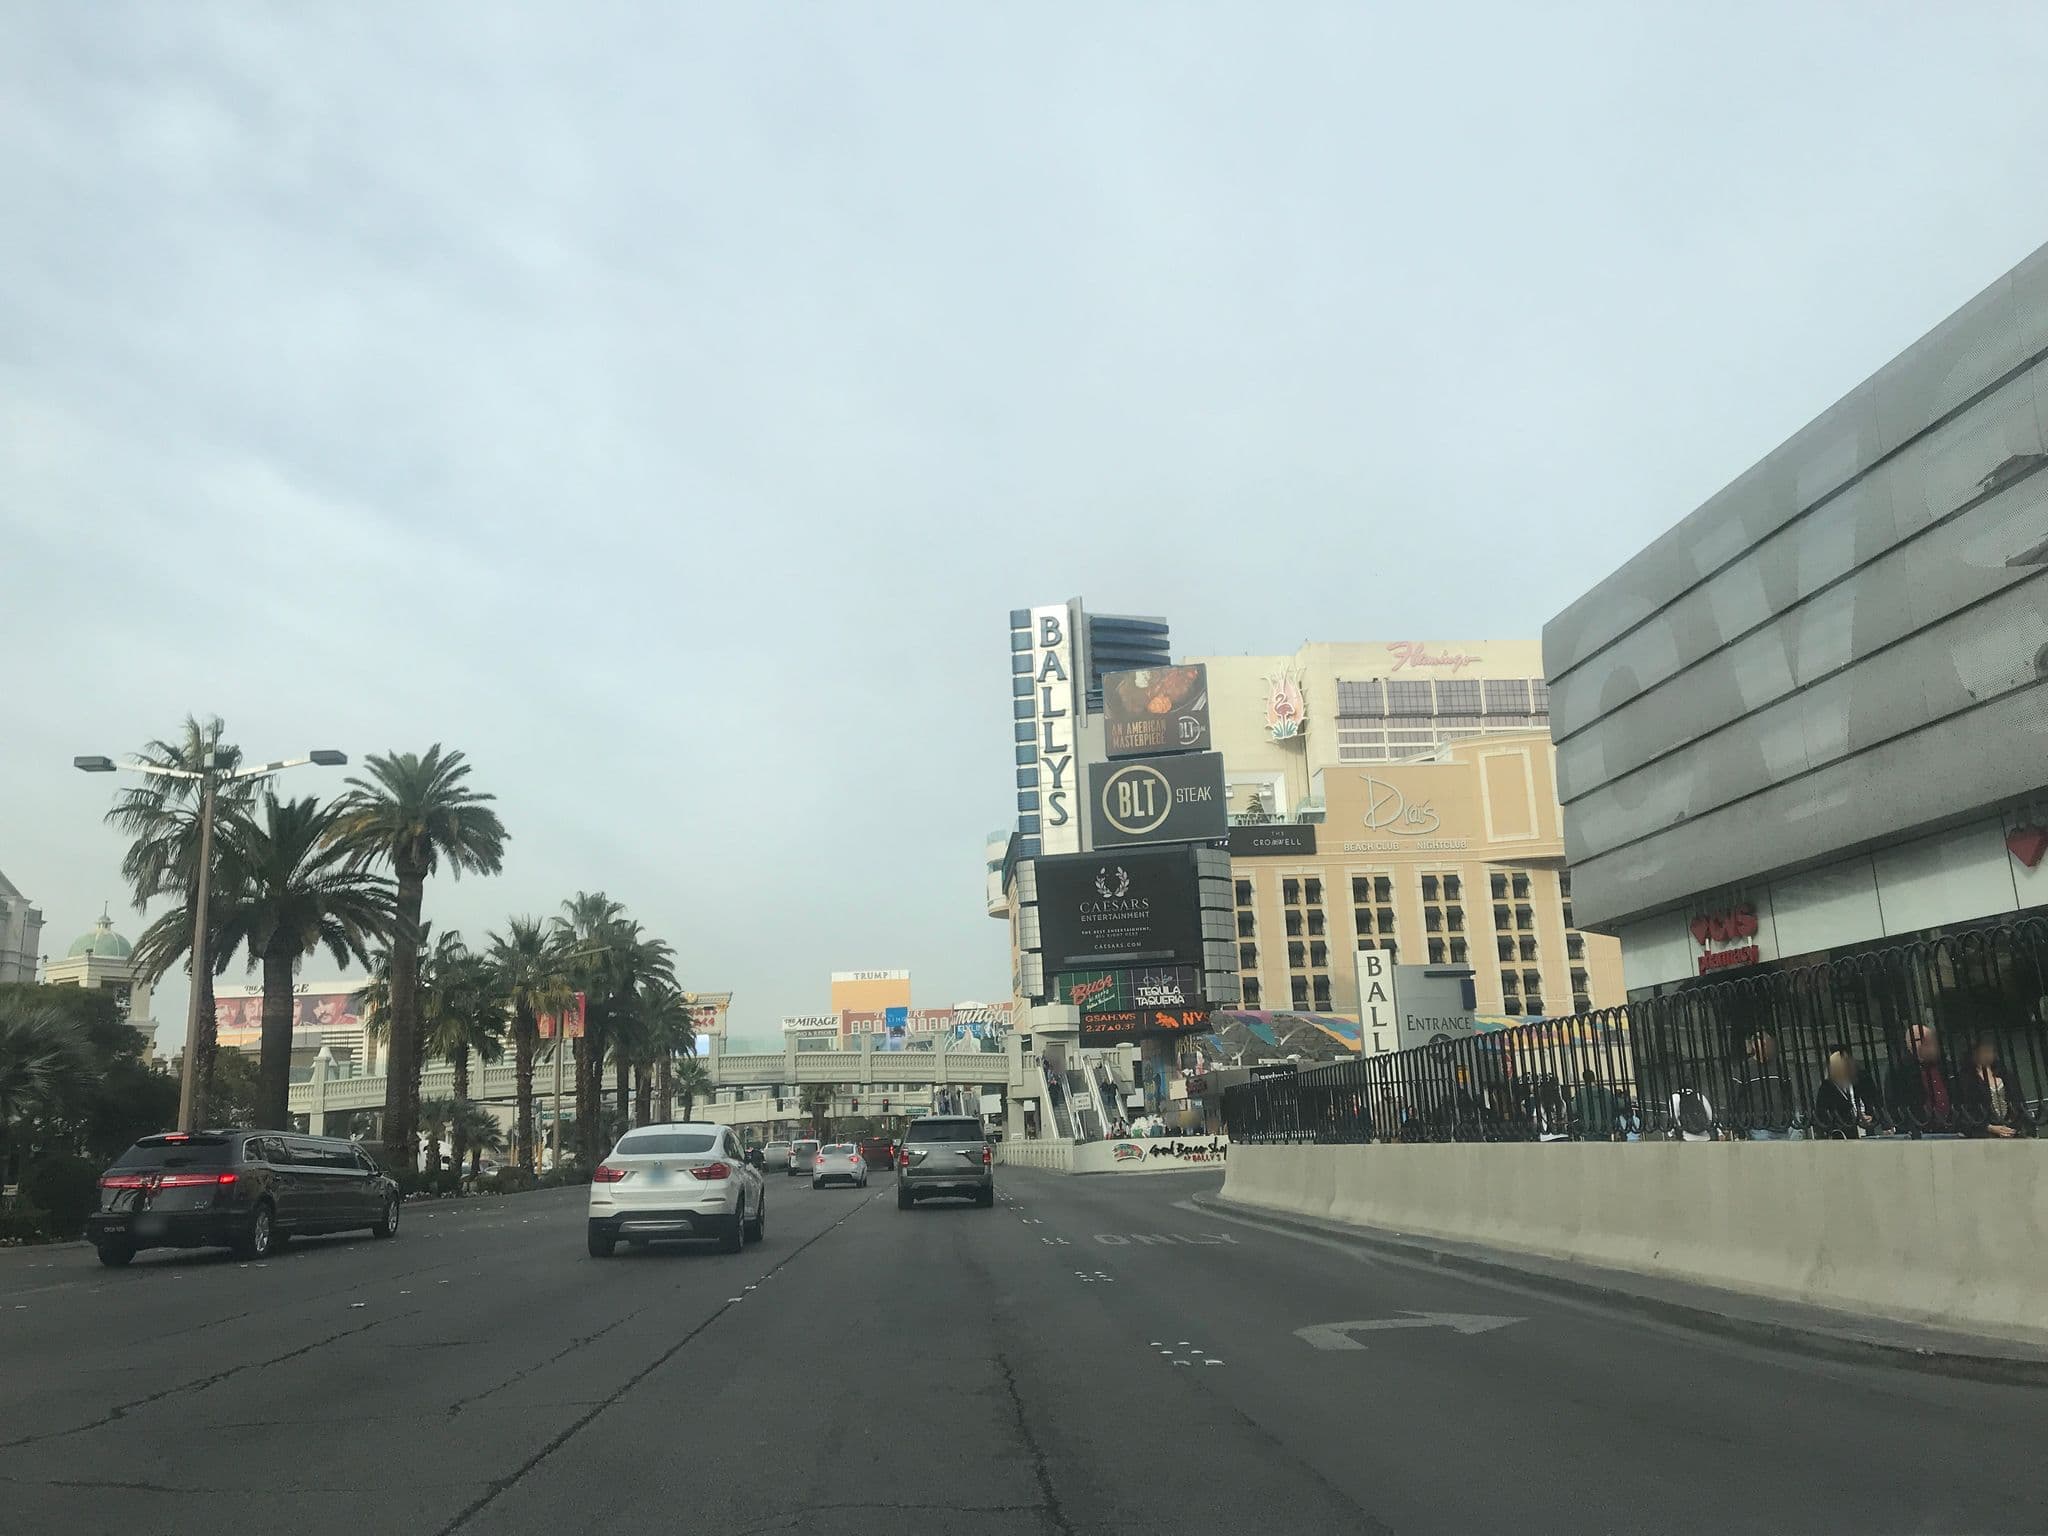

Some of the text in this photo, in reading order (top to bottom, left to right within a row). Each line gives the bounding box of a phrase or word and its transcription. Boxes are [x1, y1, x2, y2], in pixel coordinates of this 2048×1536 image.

[1386, 641, 1481, 672] Flamingo
[1117, 778, 1156, 819] BLT
[1175, 785, 1212, 804] STEAK
[1252, 838, 1302, 847] CROMWELL
[1416, 839, 1467, 850] NIGHTCLUB
[1079, 898, 1149, 914] CAESARS
[1081, 911, 1149, 922] ENTERTAINMENT
[854, 972, 888, 980] TRUMP
[1137, 985, 1181, 996] TEQUILA
[1136, 995, 1185, 1006] TAQUERIA
[790, 1016, 838, 1027] MIRAGE
[1094, 1232, 1240, 1246] ONLY
